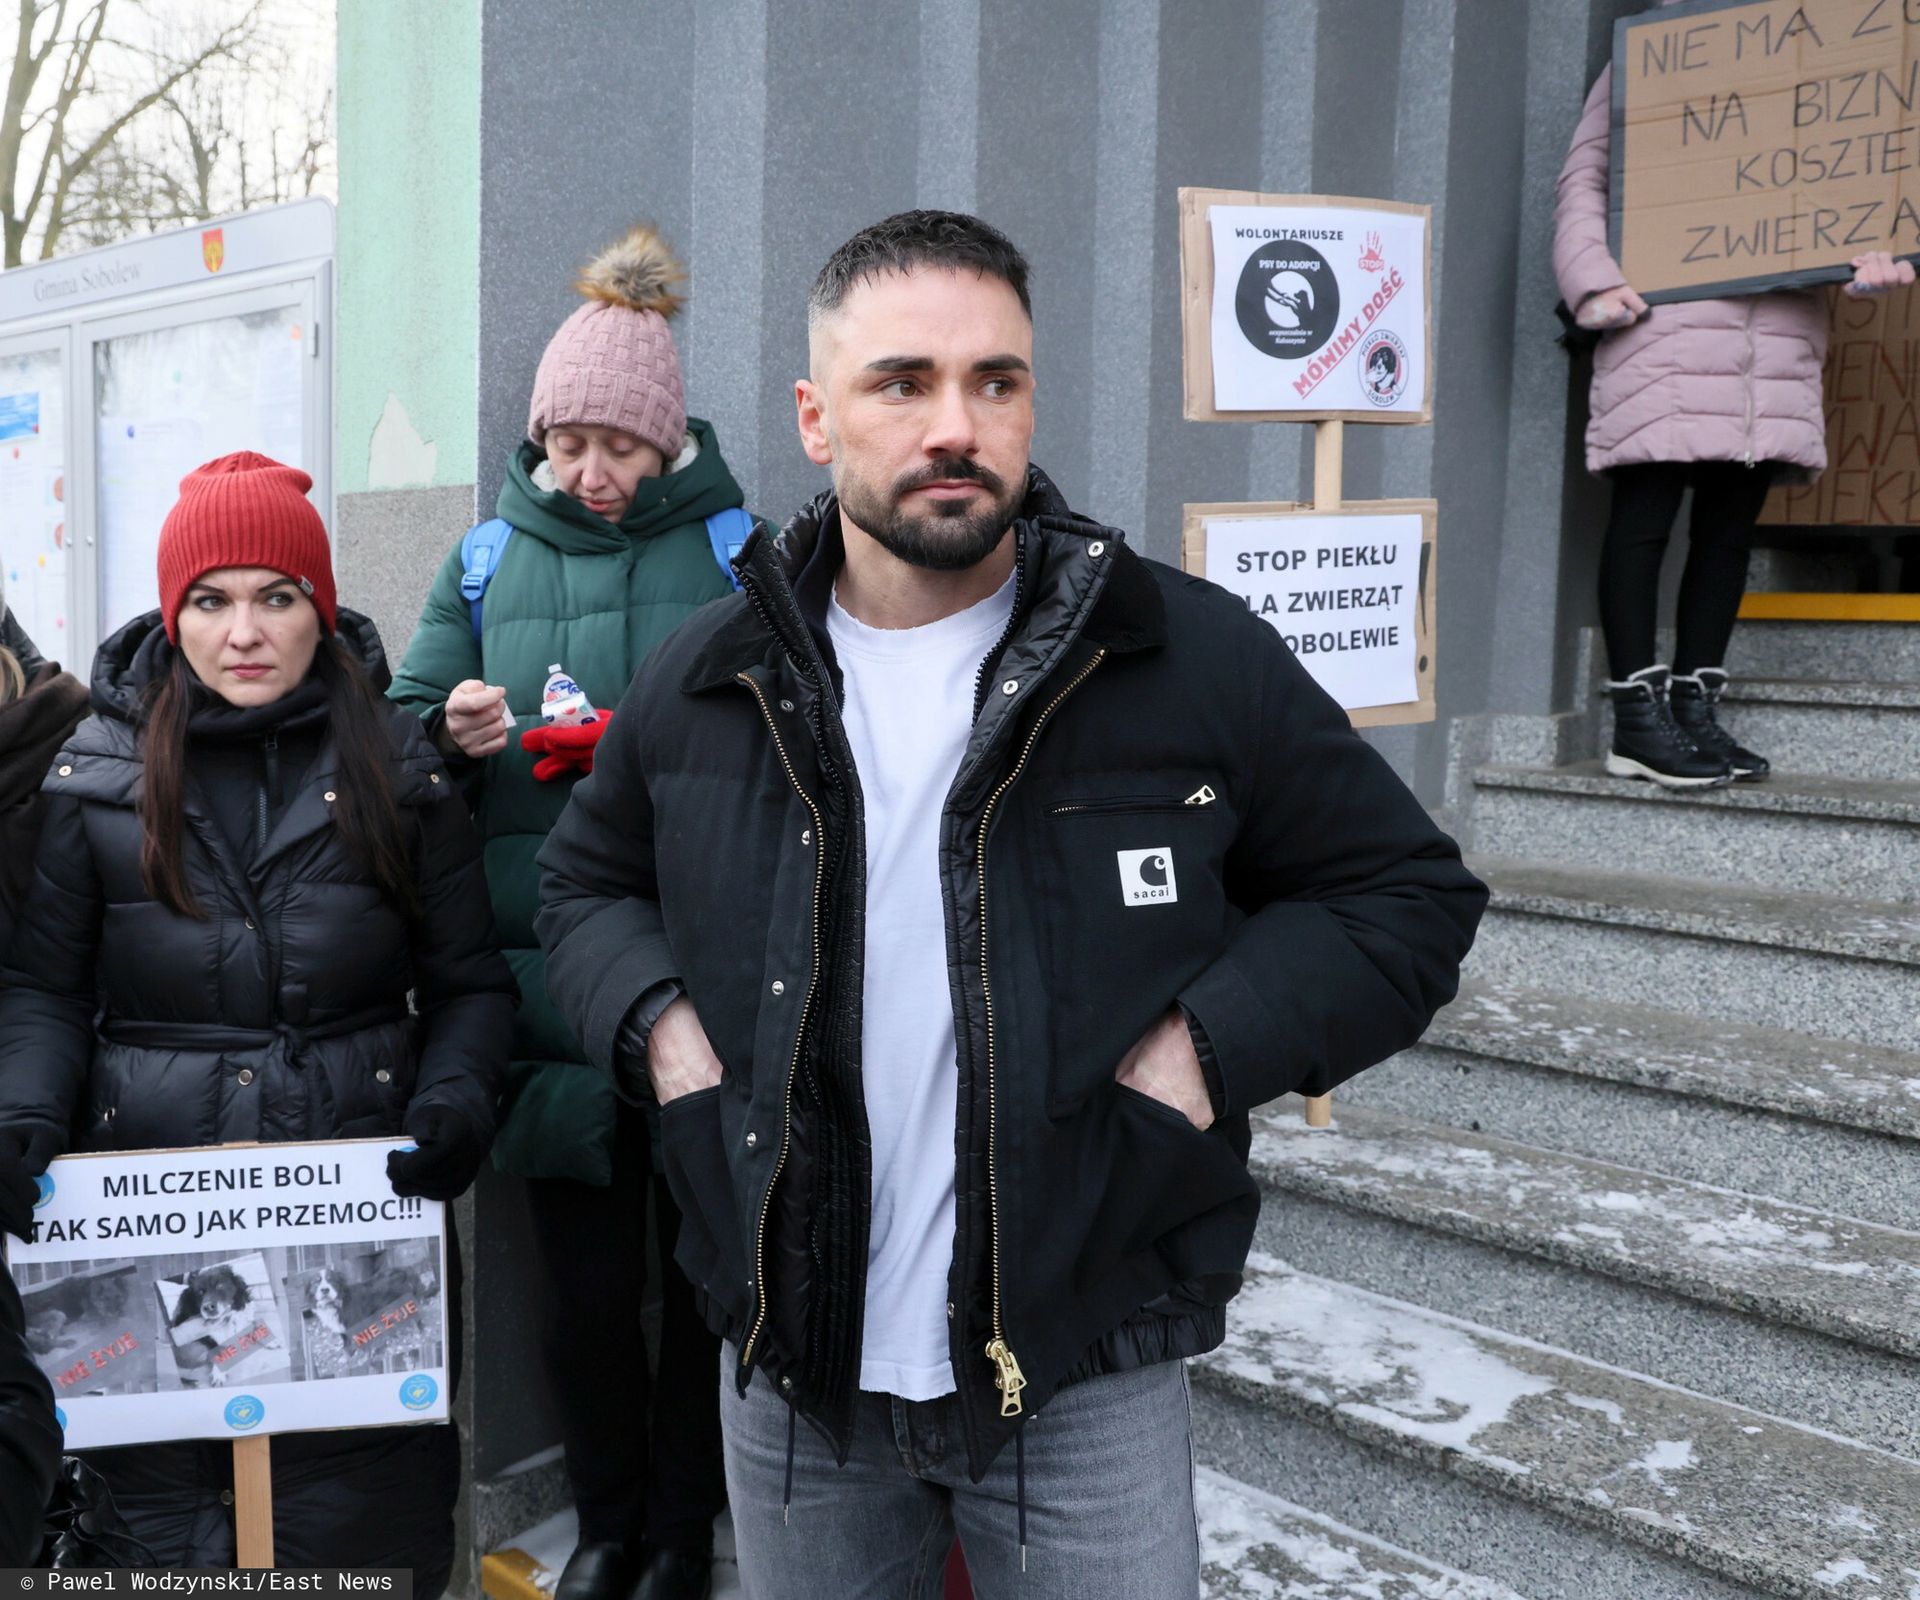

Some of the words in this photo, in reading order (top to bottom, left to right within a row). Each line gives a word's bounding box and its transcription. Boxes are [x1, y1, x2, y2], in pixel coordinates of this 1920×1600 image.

[1643, 23, 1720, 77] NIE
[1736, 7, 1824, 61] MA
[1682, 91, 1748, 146] NA
[1793, 60, 1919, 128] BIZN
[1736, 125, 1920, 191] KOSZTE
[1235, 228, 1344, 240] WOLONTARIUSZE
[33, 278, 78, 302] Gmina
[81, 259, 143, 292] Sobolew
[1259, 260, 1275, 269] PSY
[1276, 260, 1288, 269] DO
[1288, 261, 1321, 271] ADOPCJI
[1292, 316, 1363, 395] MÓWIMY
[1362, 267, 1404, 322] DOŚĆ
[1236, 549, 1307, 573] STOP
[1317, 545, 1397, 569] PIEKŁU
[1246, 594, 1279, 615] LA
[1287, 585, 1403, 613] ZWIERZĄT
[1284, 626, 1399, 655] OBOLEWIE
[1133, 886, 1169, 899] sacai
[103, 1167, 263, 1198] MILCZENIE
[274, 1163, 342, 1187] BOLI
[32, 1219, 88, 1243] TAK
[97, 1211, 187, 1239] SAMO
[194, 1208, 247, 1238] JAK
[257, 1197, 423, 1229] PRZEMOC!!!
[353, 1323, 381, 1347] NIE
[381, 1301, 418, 1329] ŻYJE
[55, 1361, 91, 1389] NIE
[90, 1332, 139, 1369] ŻYJE
